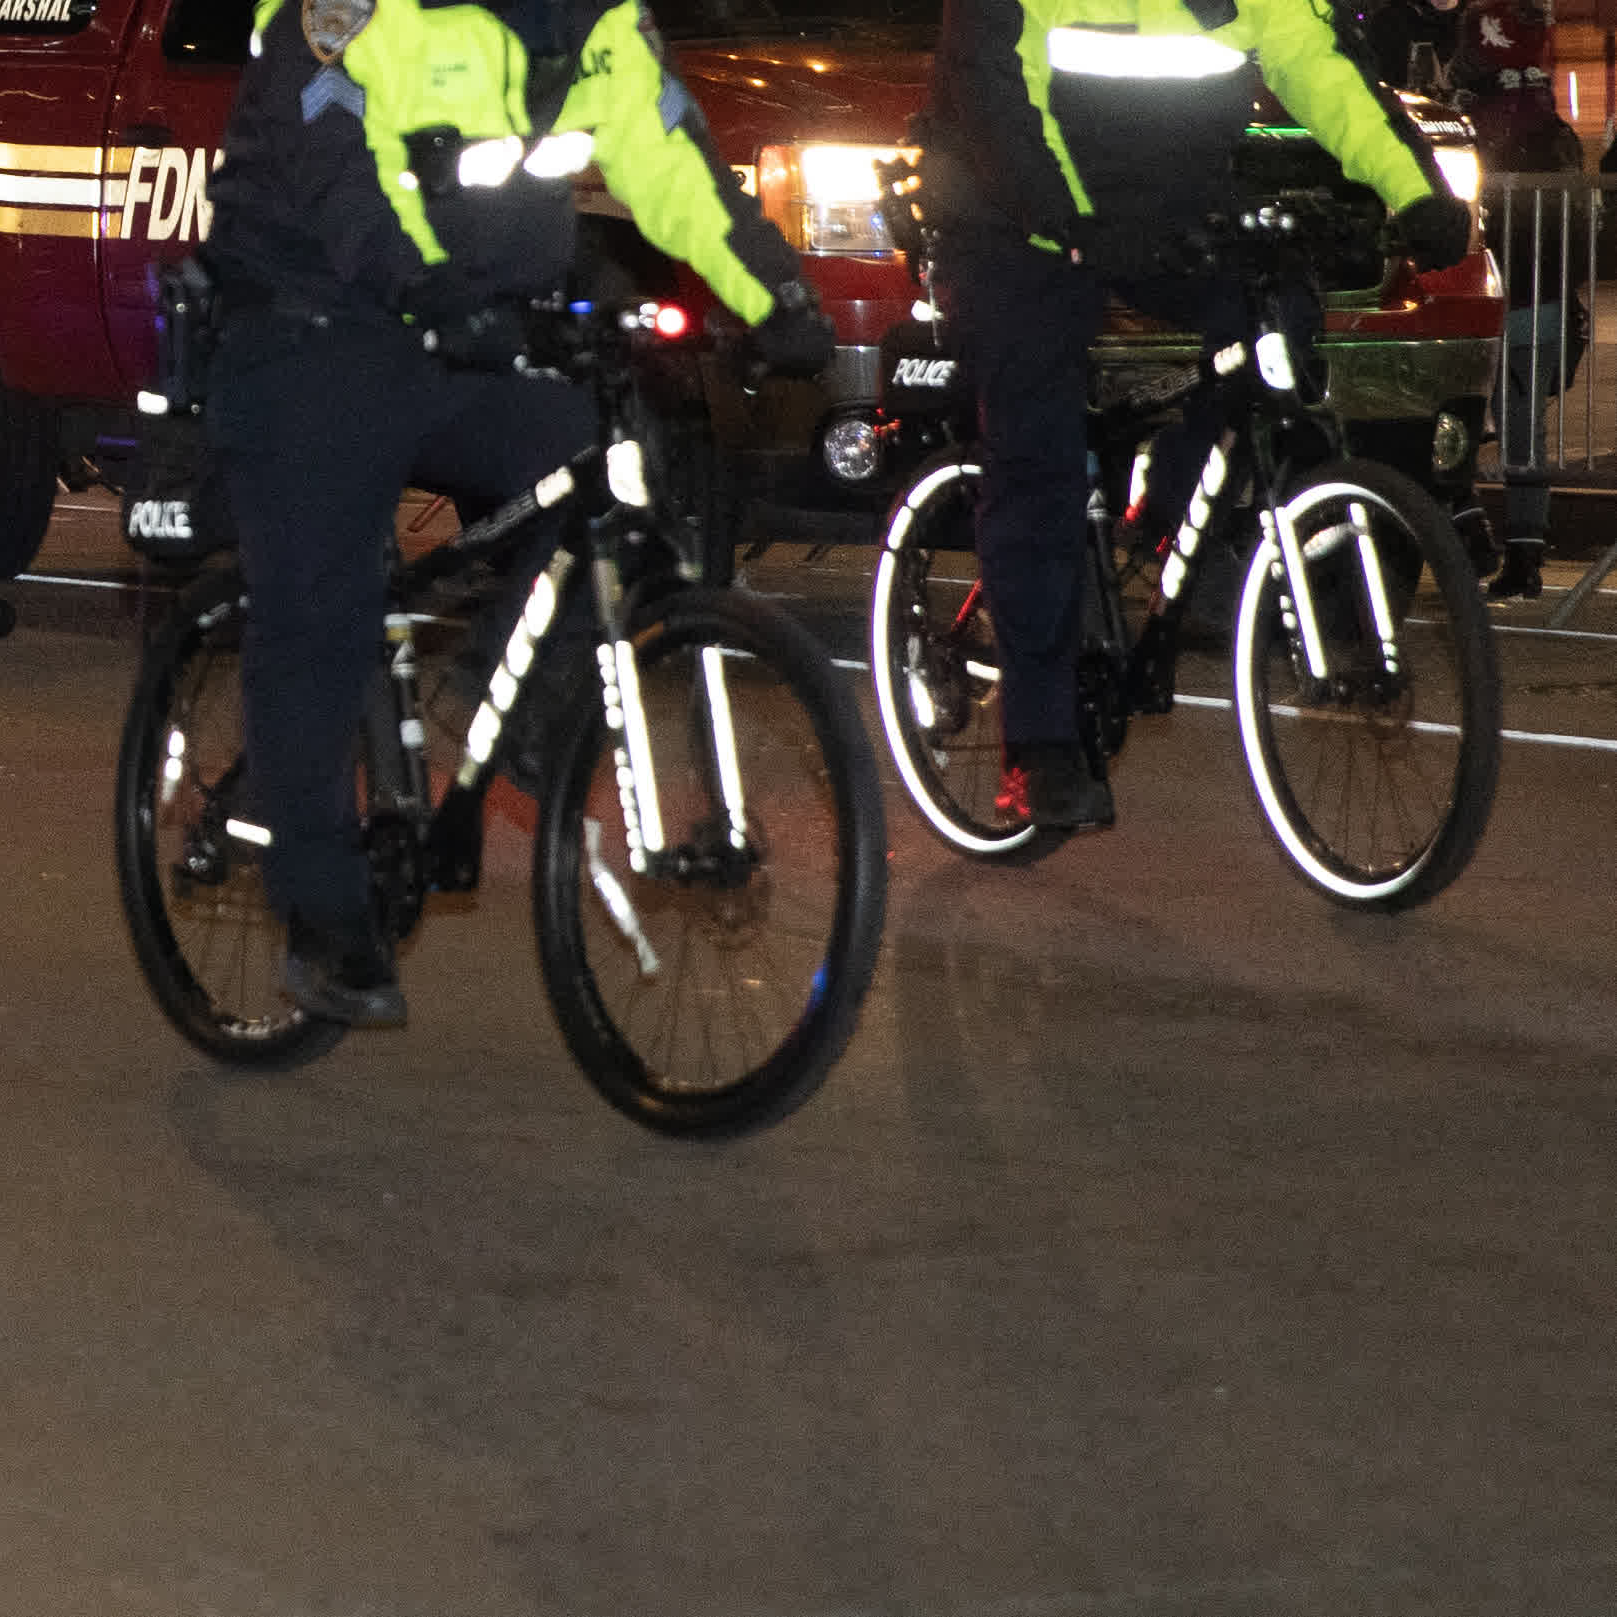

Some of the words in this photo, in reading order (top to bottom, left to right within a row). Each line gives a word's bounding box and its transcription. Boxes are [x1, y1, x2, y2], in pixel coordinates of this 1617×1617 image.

[120, 146, 226, 242] FDN
[892, 357, 957, 387] POLICE
[128, 499, 193, 538] POLICE
